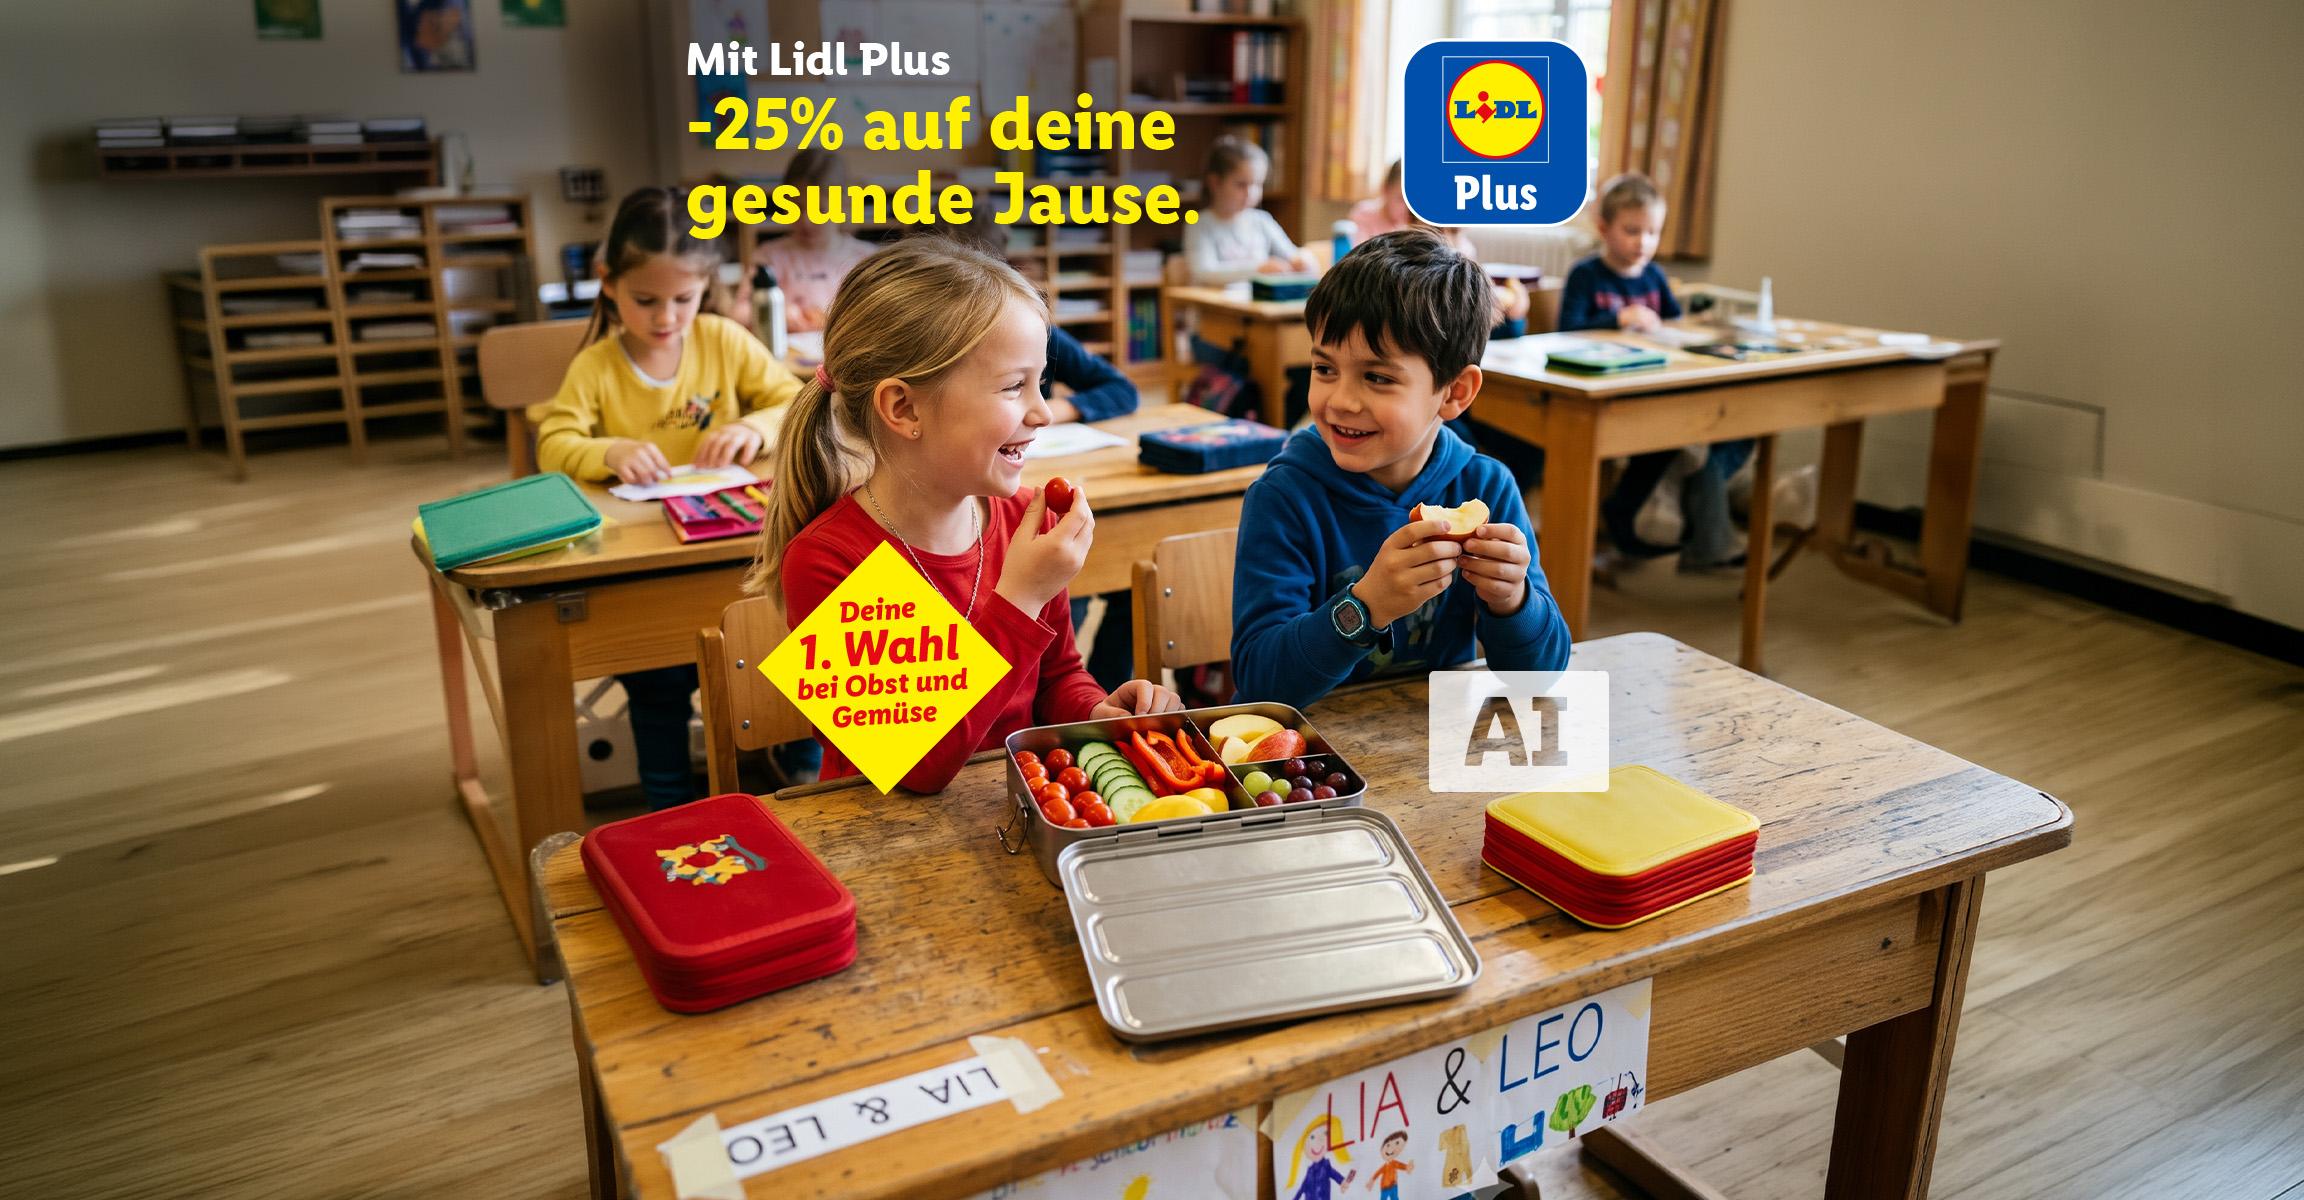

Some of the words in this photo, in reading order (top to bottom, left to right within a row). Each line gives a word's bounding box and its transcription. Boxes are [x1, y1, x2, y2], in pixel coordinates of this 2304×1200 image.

[919, 1066, 1000, 1105] LIA
[1326, 1071, 1410, 1152] LIA
[1436, 1046, 1473, 1116] &
[1500, 1002, 1604, 1093] LEO
[852, 1096, 891, 1126] &
[726, 1115, 828, 1166] LEO
